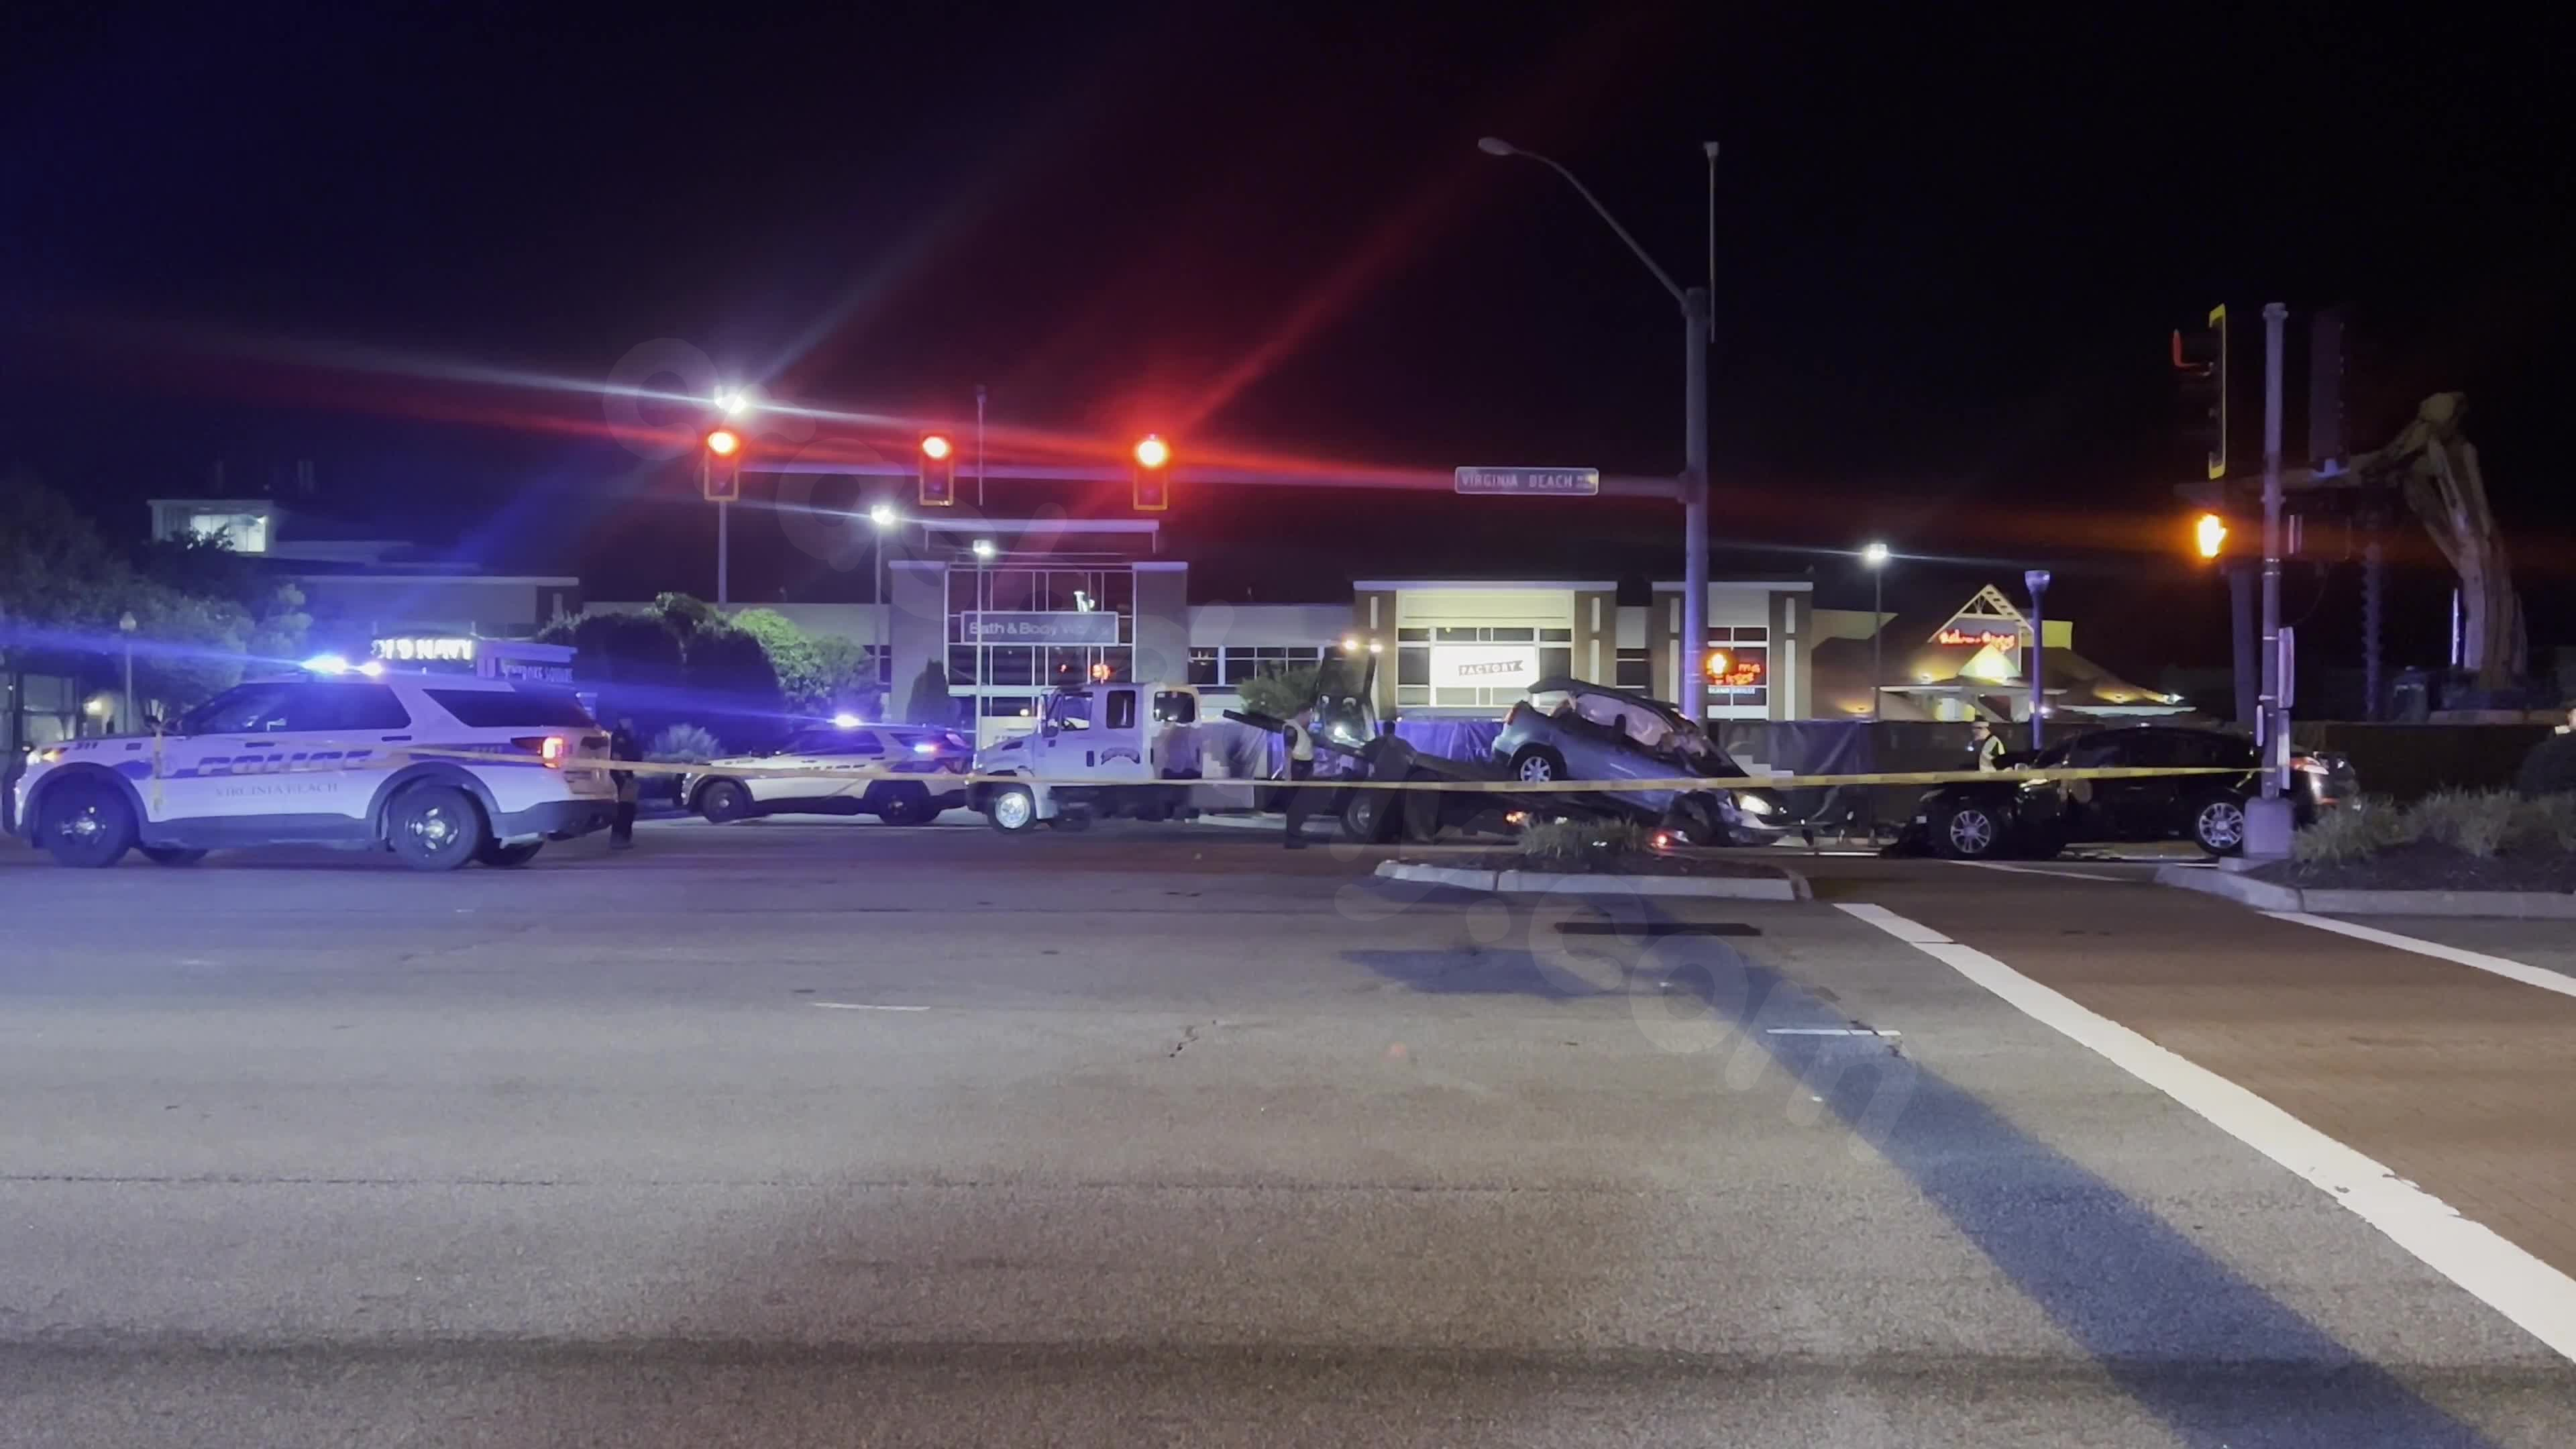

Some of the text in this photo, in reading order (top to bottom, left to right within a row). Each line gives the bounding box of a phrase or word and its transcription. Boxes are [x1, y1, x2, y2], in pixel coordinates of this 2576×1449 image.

[1461, 473, 1519, 488] VIRGINIA
[1528, 474, 1573, 489] BEACH
[969, 621, 1005, 635] Bath
[1006, 623, 1018, 635] &
[1019, 622, 1057, 637] Body
[1460, 662, 1516, 676] FACTORY
[197, 749, 373, 777] POLICE
